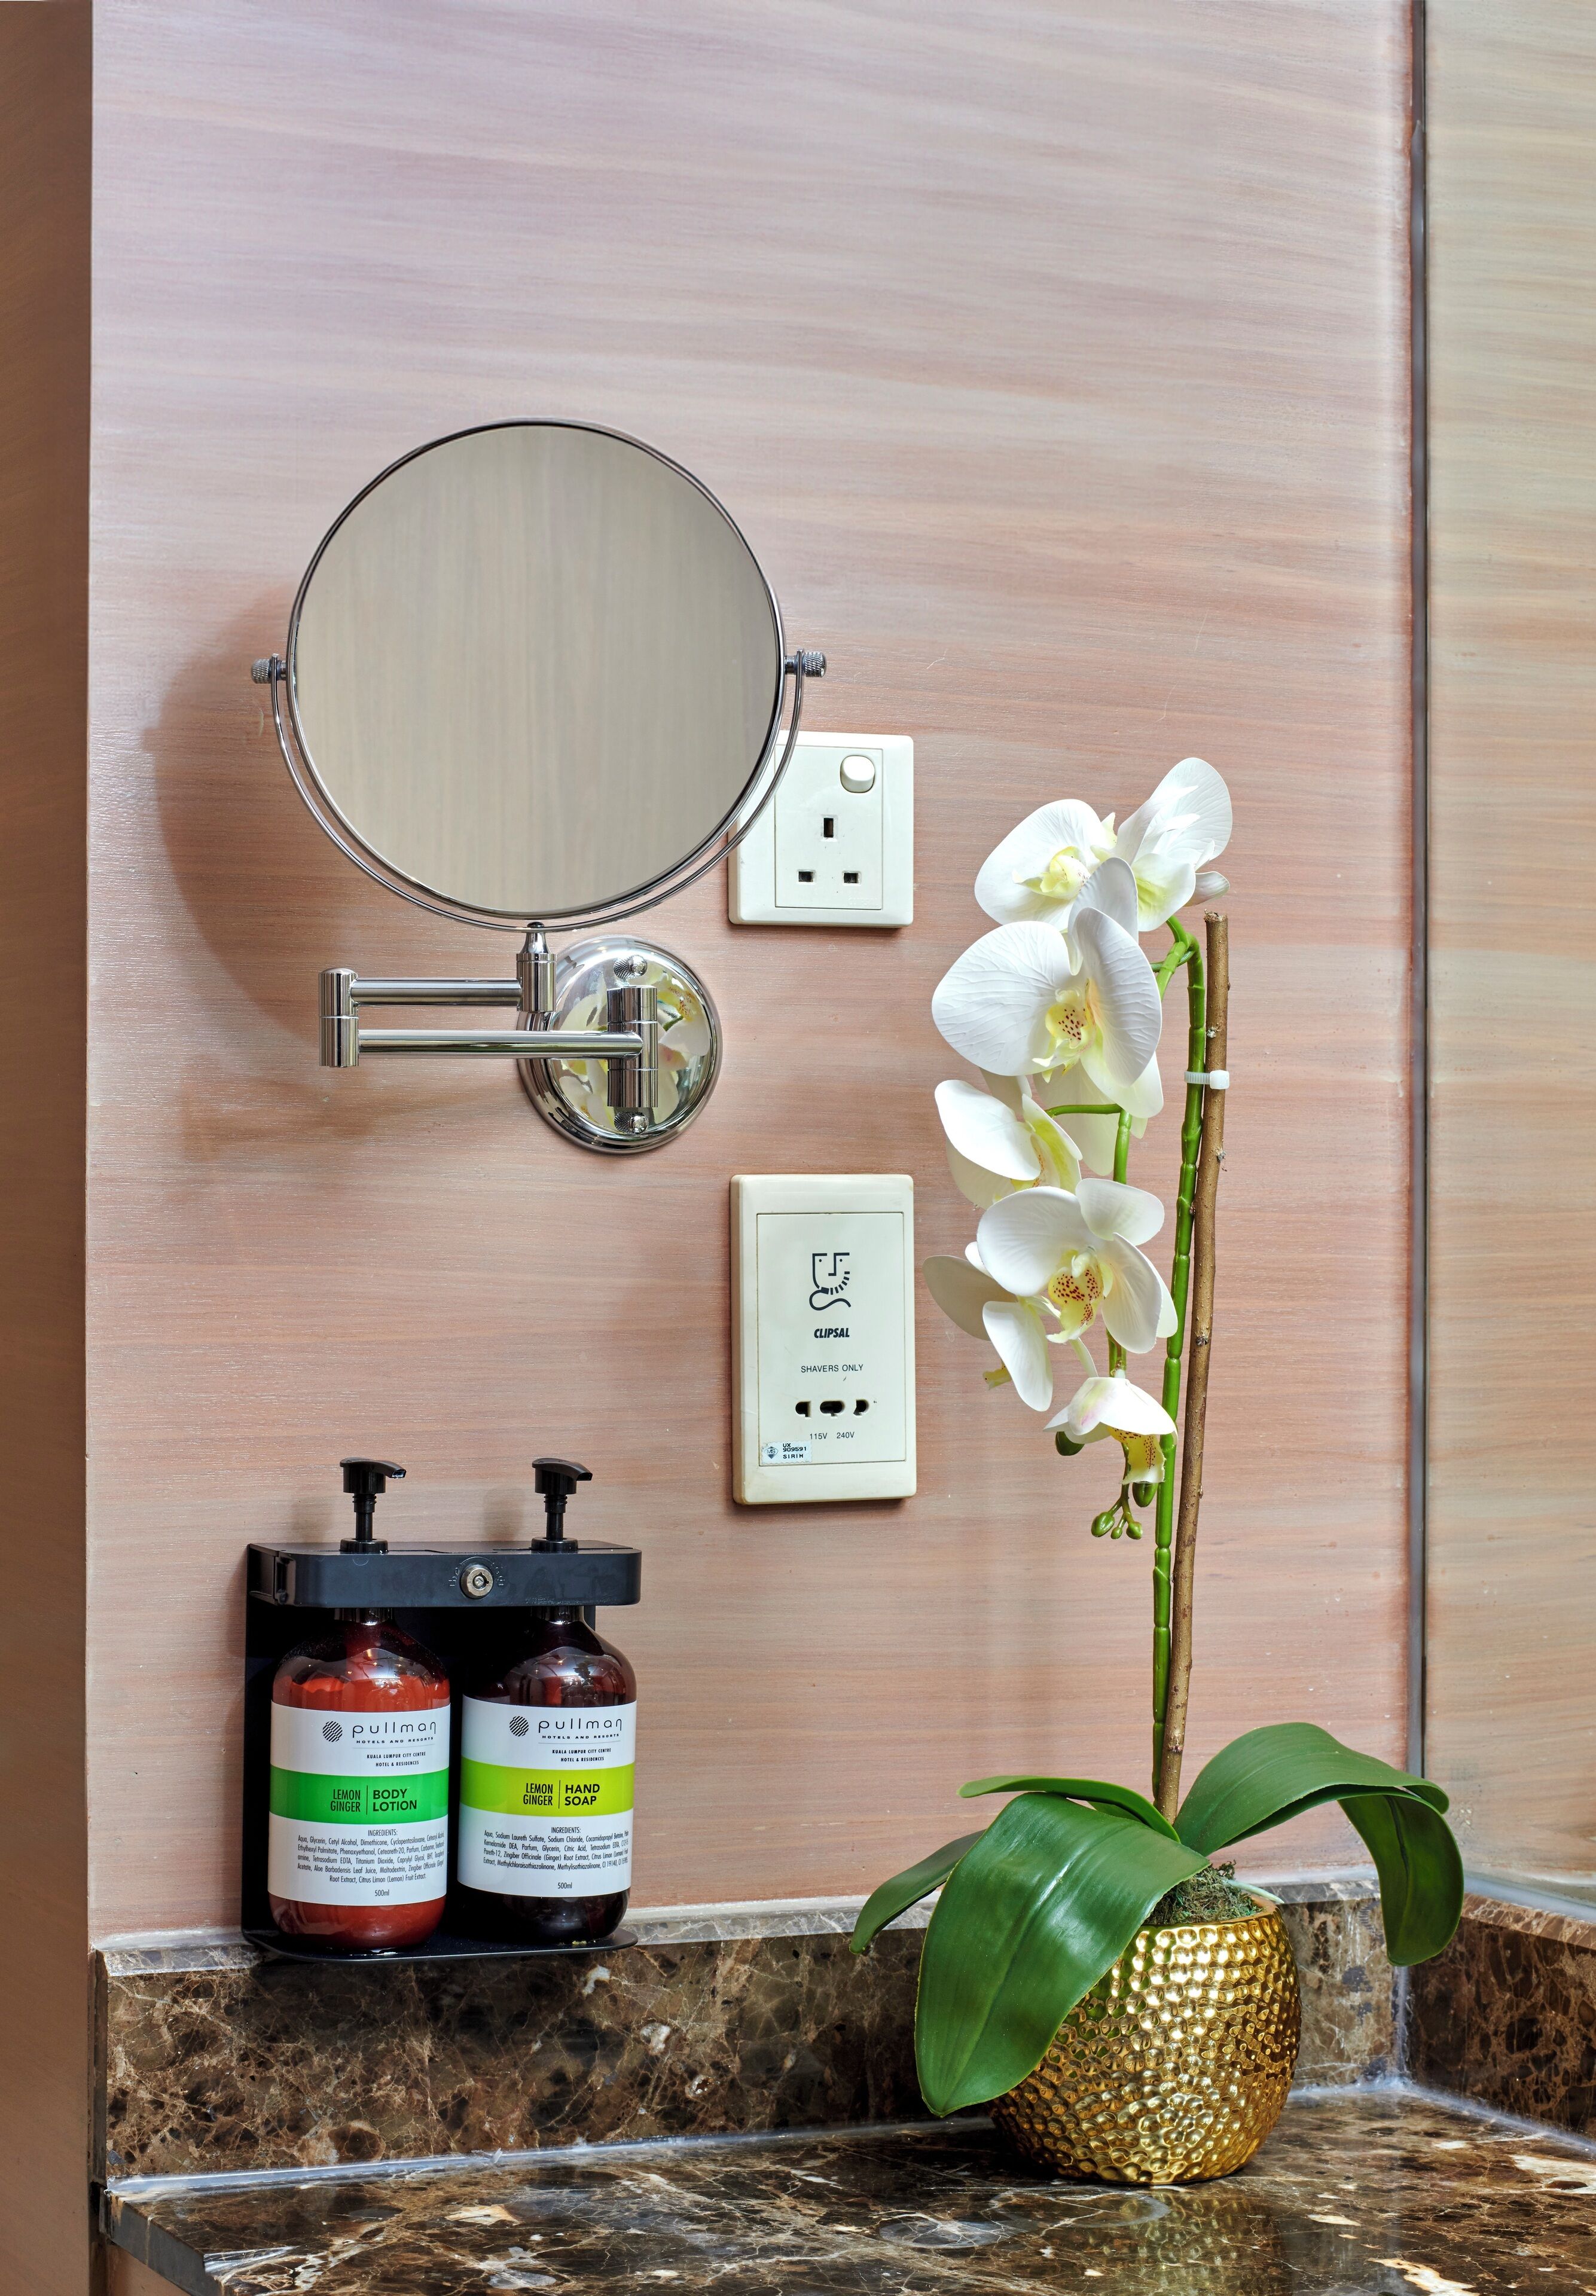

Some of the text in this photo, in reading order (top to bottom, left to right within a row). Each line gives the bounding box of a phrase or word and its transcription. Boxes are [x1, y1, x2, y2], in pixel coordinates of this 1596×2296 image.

[814, 1328, 850, 1338] CLIPSAL
[353, 1722, 436, 1738] pullman
[539, 1718, 621, 1733] pullman
[373, 1788, 407, 1799] BODY
[526, 1783, 553, 1794] LEMON
[566, 1784, 600, 1794] HAND
[333, 1789, 360, 1800] LEMON
[523, 1794, 553, 1806] GINGER
[330, 1801, 360, 1812] GINGER
[373, 1800, 417, 1812] LOTION
[564, 1796, 597, 1806] SOAP
[310, 1836, 326, 1845] Glycerin,
[318, 1846, 338, 1855] Palmitate,
